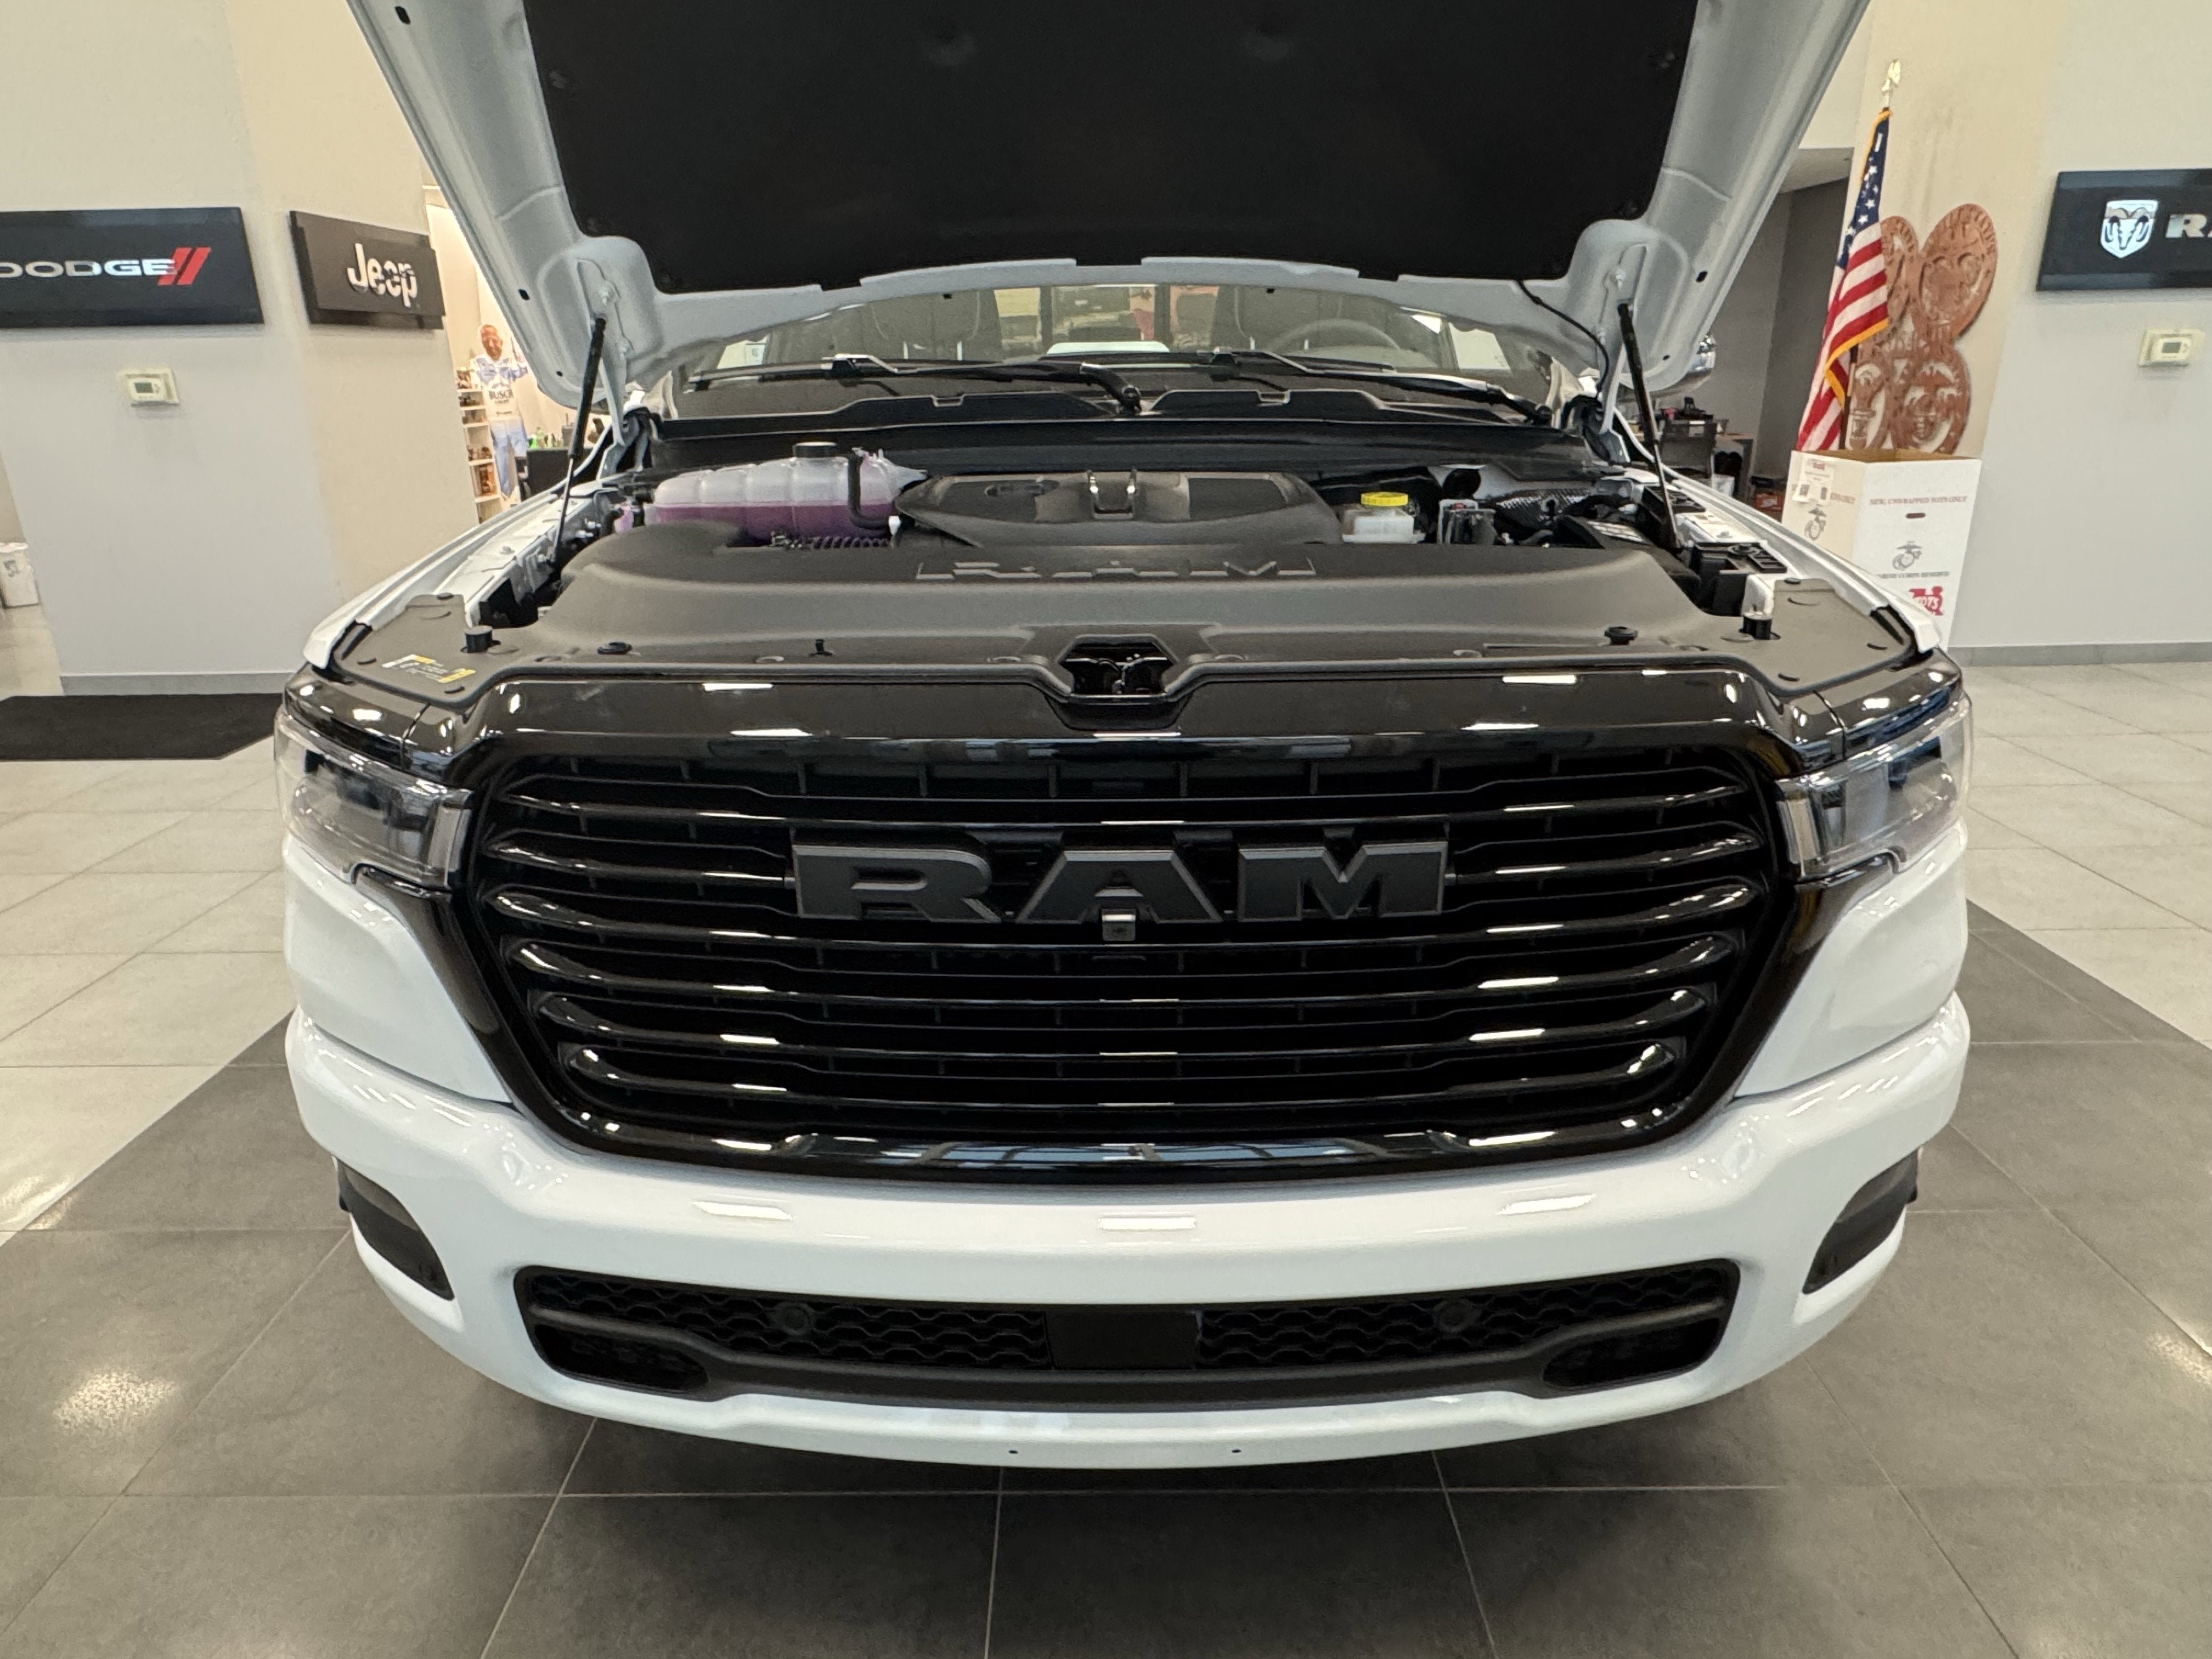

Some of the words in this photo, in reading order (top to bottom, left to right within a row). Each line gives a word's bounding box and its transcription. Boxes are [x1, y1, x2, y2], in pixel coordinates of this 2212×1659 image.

[2165, 214, 2212, 238] R
[347, 242, 418, 307] Jeep
[792, 842, 1448, 924] RAM
